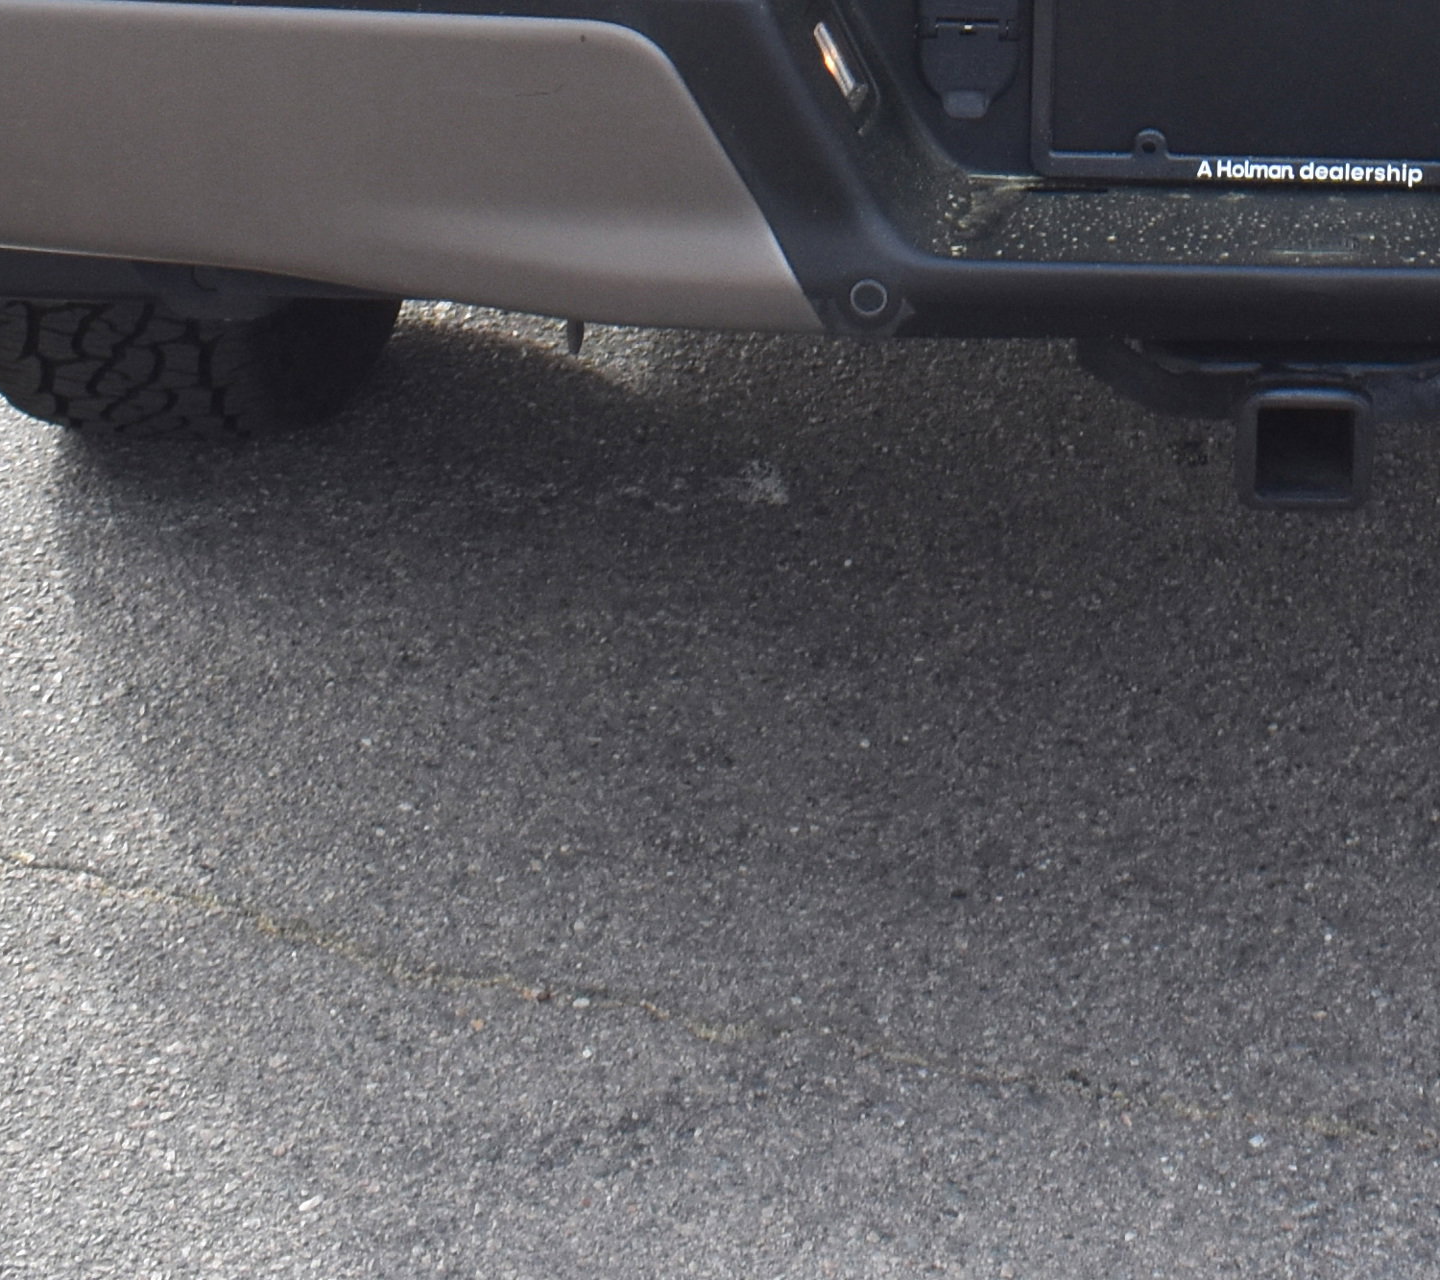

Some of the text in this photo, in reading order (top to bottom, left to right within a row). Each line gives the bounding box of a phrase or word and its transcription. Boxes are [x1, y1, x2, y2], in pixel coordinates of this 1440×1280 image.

[1197, 160, 1423, 187] A Holman dealership
